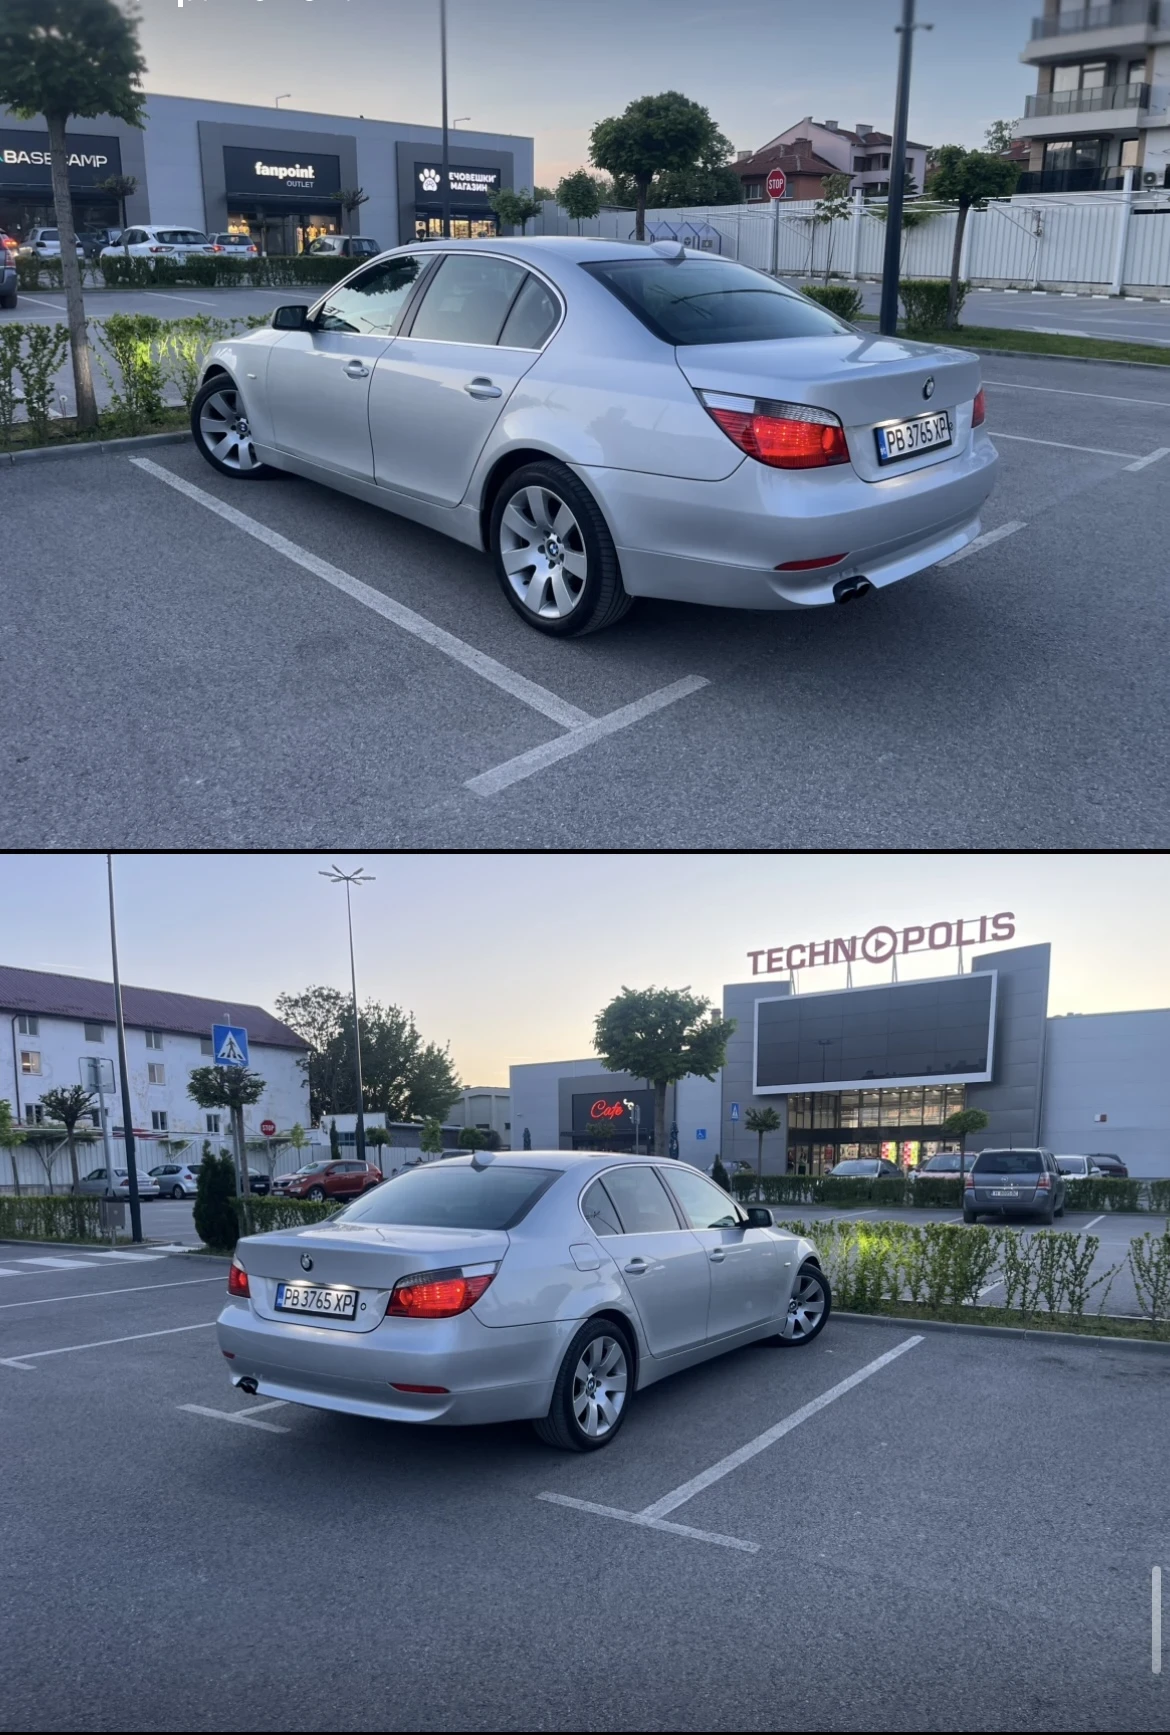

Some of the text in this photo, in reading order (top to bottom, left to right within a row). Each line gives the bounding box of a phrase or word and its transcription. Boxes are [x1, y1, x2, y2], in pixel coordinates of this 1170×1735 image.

[3, 150, 108, 168] BASEAMP
[286, 180, 314, 188] OUTLET
[450, 182, 488, 192] МАГАЗИН
[768, 179, 784, 189] STOP
[886, 416, 946, 454] PB 3765 XP
[284, 1288, 300, 1306] PB
[301, 1290, 332, 1310] 3765
[333, 1293, 353, 1312] XP
